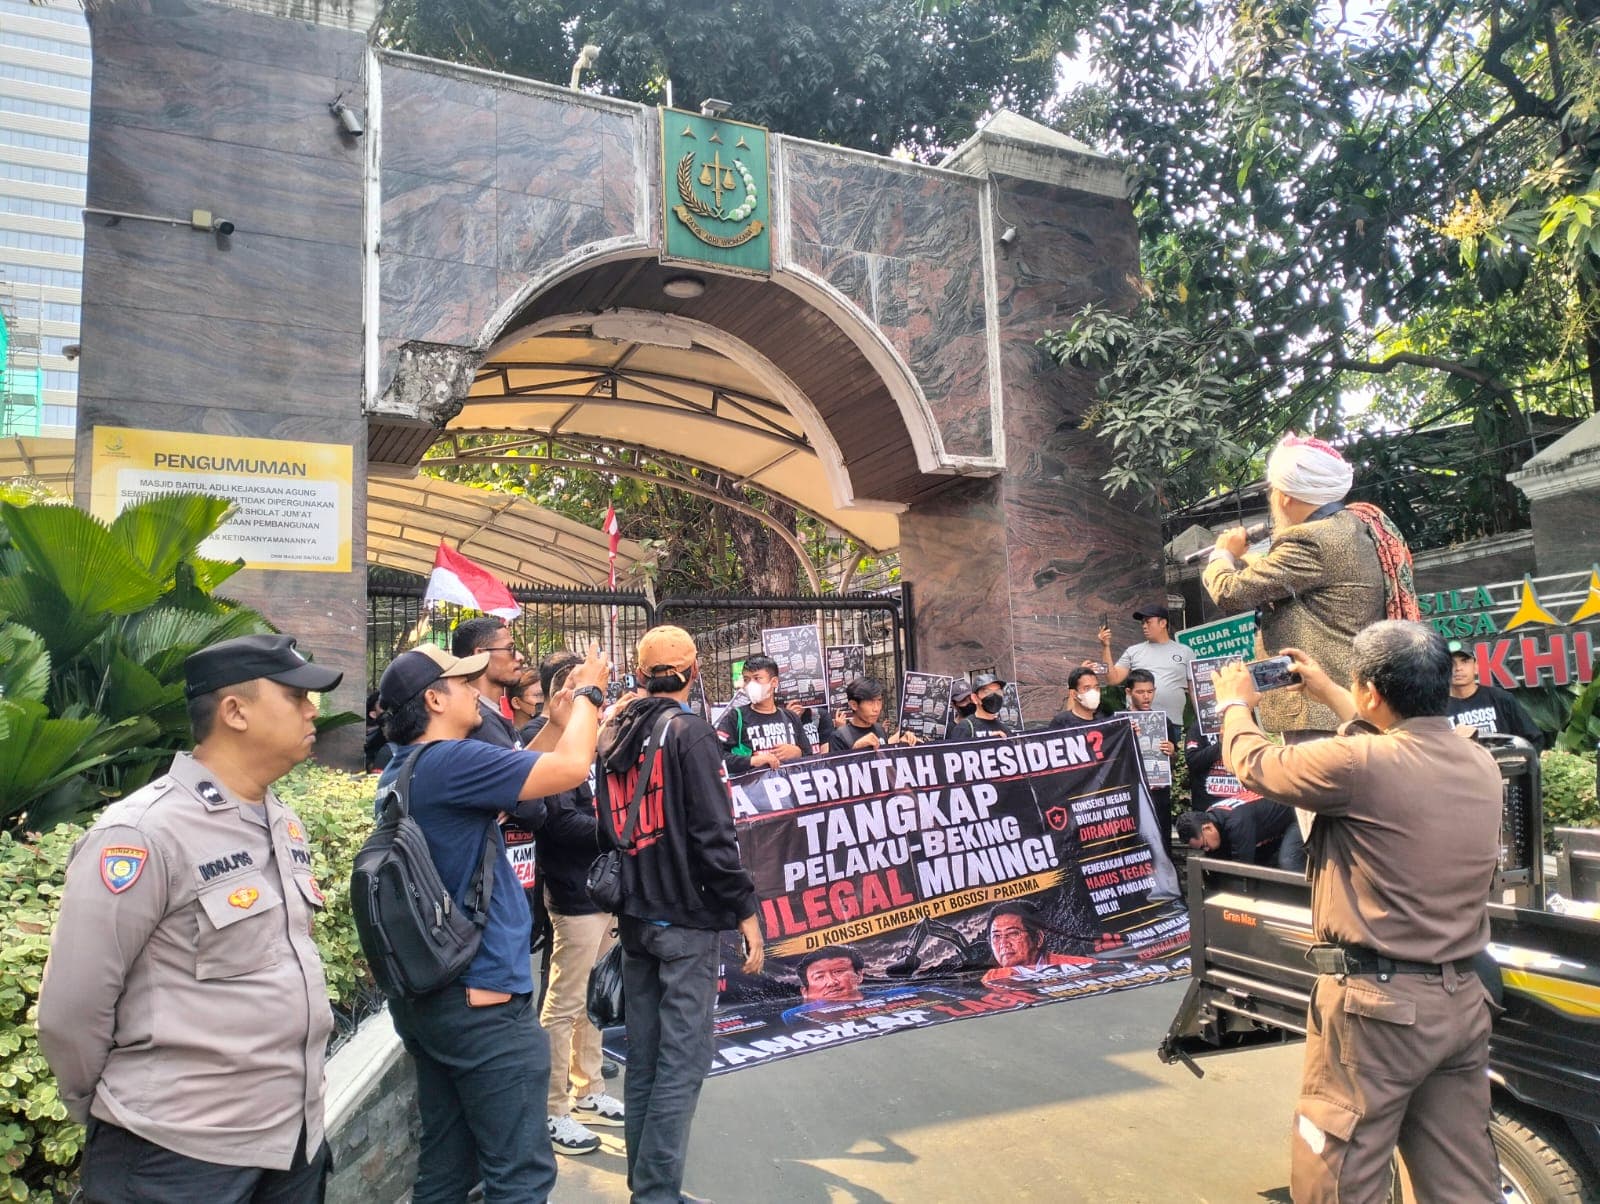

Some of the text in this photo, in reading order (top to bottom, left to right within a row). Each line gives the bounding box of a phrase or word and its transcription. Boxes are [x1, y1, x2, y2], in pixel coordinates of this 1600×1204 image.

[154, 452, 307, 476] PENGUMUMAN
[140, 479, 317, 497] MASJID BAITUL ADLI KEJAKSAAN AGUNG
[241, 496, 266, 505] TIDAK
[268, 498, 335, 509] DIPERGUNAKAN
[245, 508, 280, 517] SHOLAT
[253, 519, 320, 529] PEMBANGUNAN
[1189, 628, 1231, 647] KELUAR
[1217, 636, 1250, 651] PINTU
[1458, 706, 1497, 726] BOSOSI
[746, 726, 760, 740] PT
[763, 754, 939, 811] PERINTAH
[943, 730, 1105, 783] PRESIDEN?
[797, 783, 998, 856] TANGKAP
[1075, 804, 1130, 826] BUKAN UNTUK
[1079, 817, 1137, 842] DIRAMPOK!
[784, 815, 1021, 892] PELAKU-BEKING
[1081, 849, 1152, 876] PENEGAKAN HUKUM
[761, 834, 1060, 940] ILEGAL MINING!
[1085, 871, 1120, 890] HARUS
[1089, 877, 1157, 903] TANPA PANDANG
[805, 878, 1040, 950] DI KONSESI TAMBANG PT BOSOSI PRATAMA
[1094, 899, 1120, 916] BULU!
[1223, 909, 1257, 928] Gran Max
